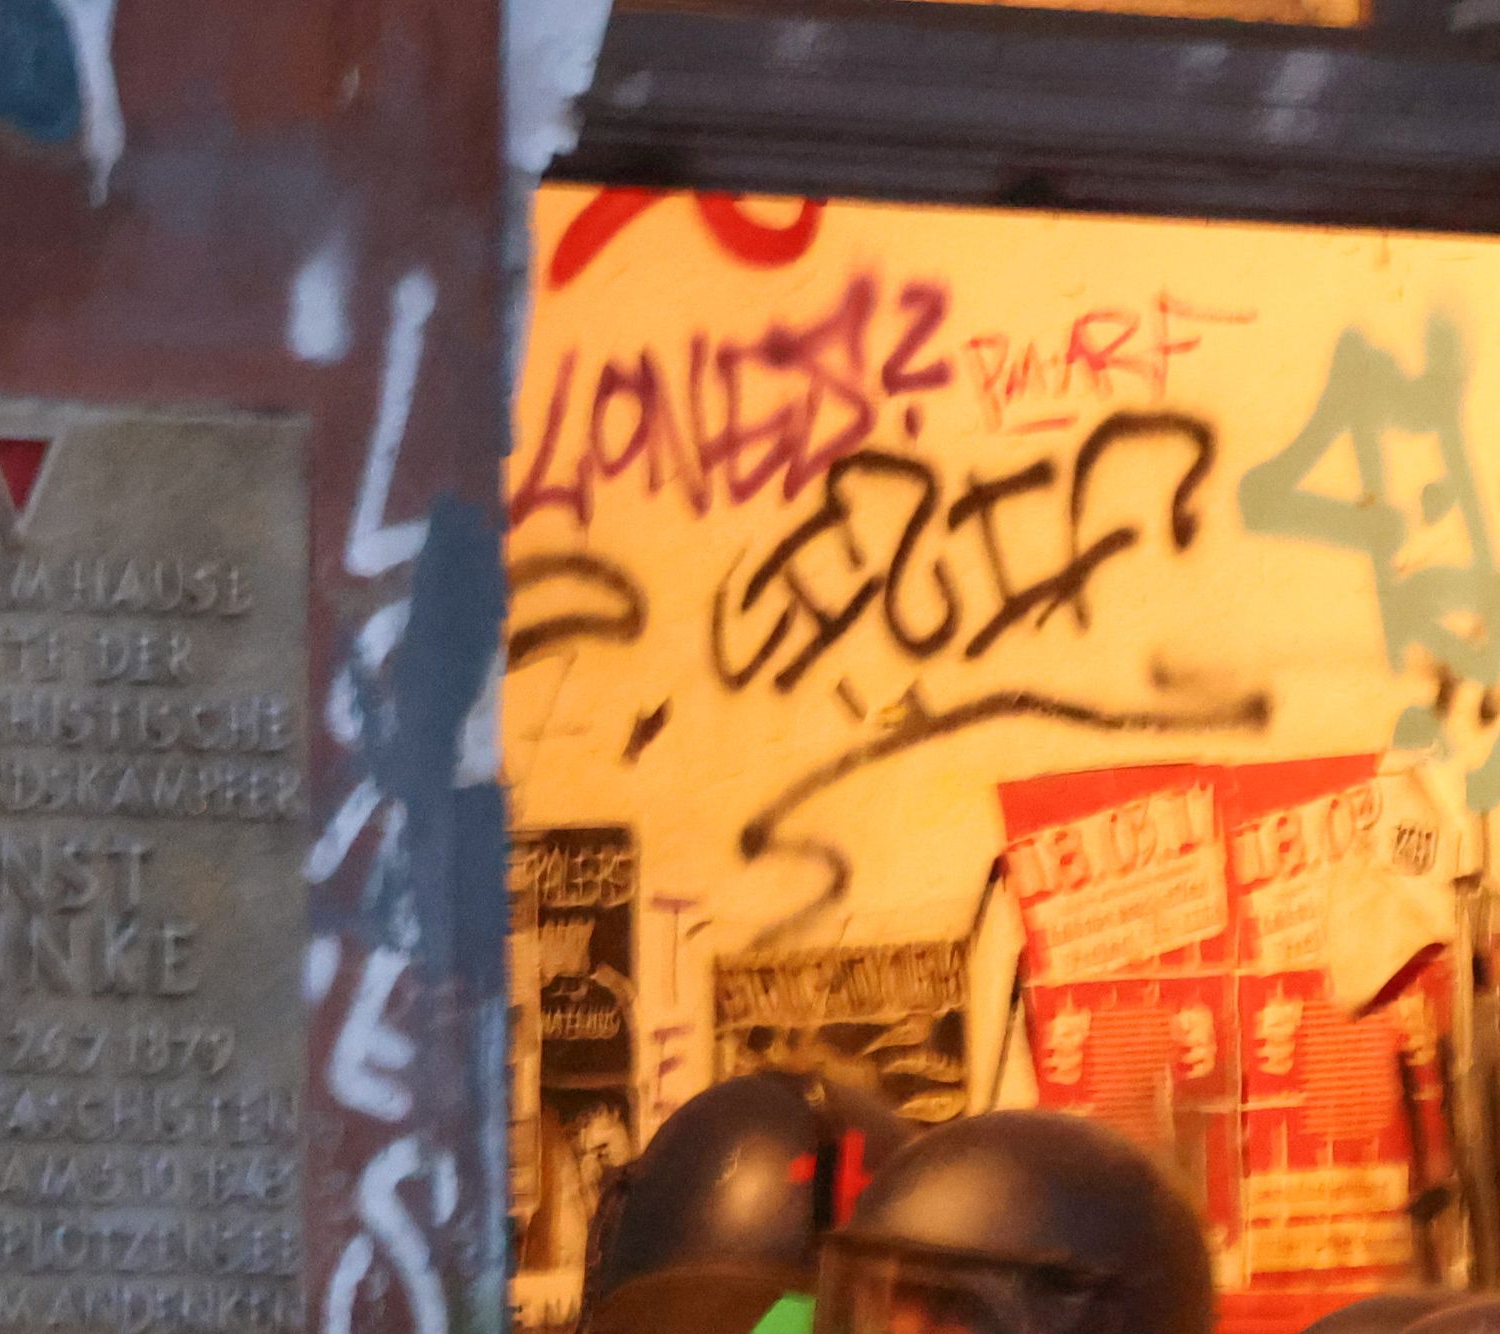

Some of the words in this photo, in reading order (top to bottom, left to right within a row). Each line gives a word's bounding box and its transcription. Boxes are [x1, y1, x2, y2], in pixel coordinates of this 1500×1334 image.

[74, 559, 254, 617] HAUSE
[97, 630, 195, 684] DER
[0, 1154, 78, 1199] AM
